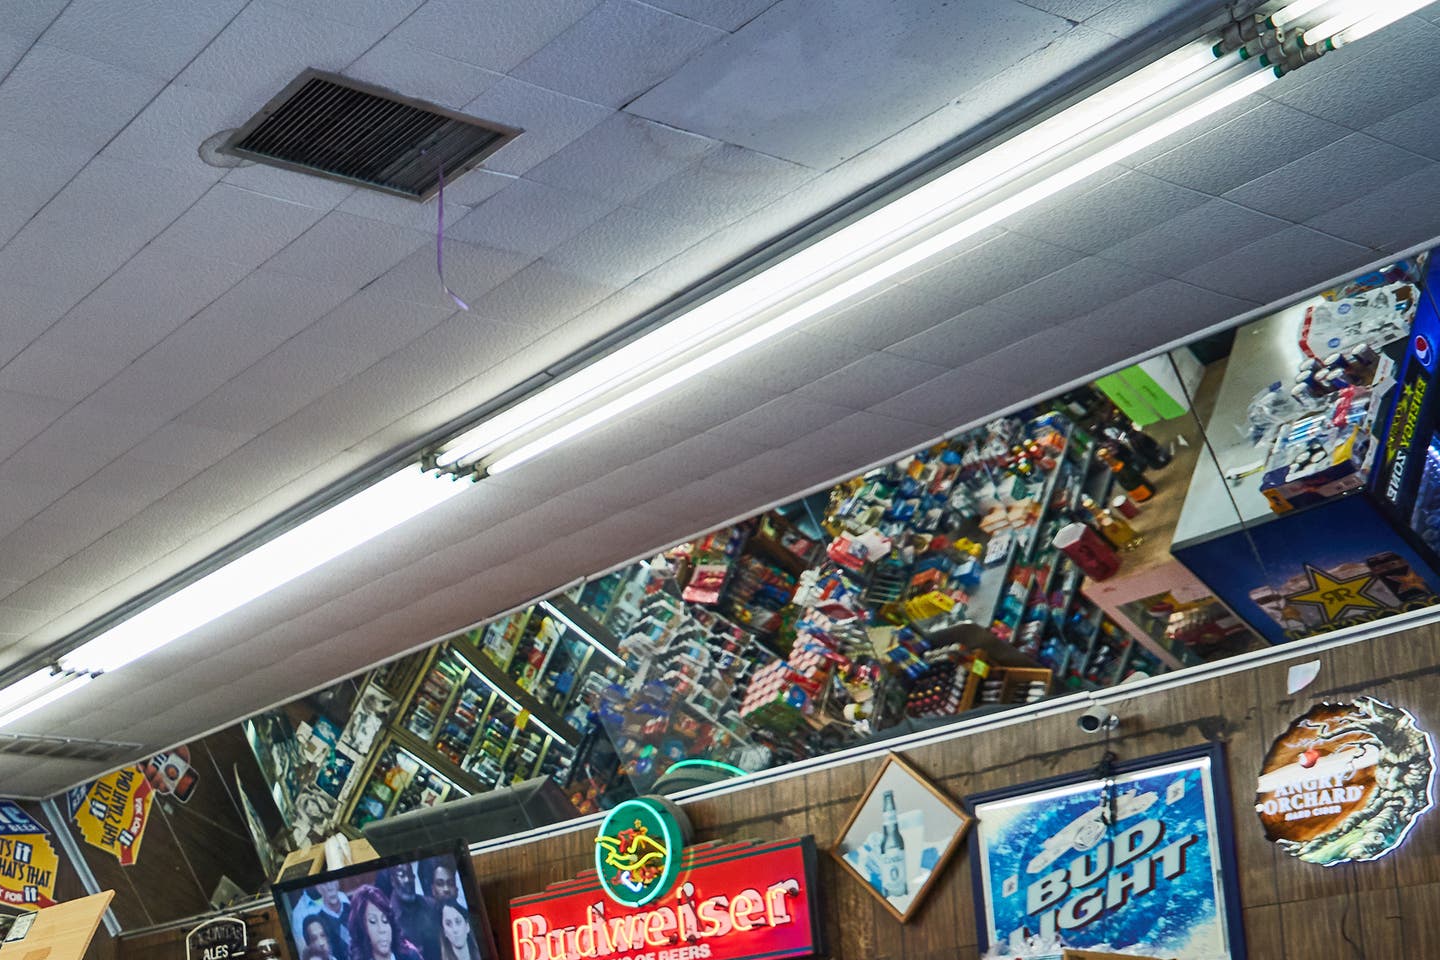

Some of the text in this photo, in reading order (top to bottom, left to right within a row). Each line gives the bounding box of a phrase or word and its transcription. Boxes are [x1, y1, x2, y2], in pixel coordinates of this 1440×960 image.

[1273, 773, 1350, 798] ANGRY
[1263, 785, 1364, 816] ORCHARD
[9, 824, 41, 832] BEER
[14, 844, 31, 862] it
[26, 865, 51, 888] THAT
[1026, 818, 1163, 917] BUD
[5, 889, 23, 903] FOR
